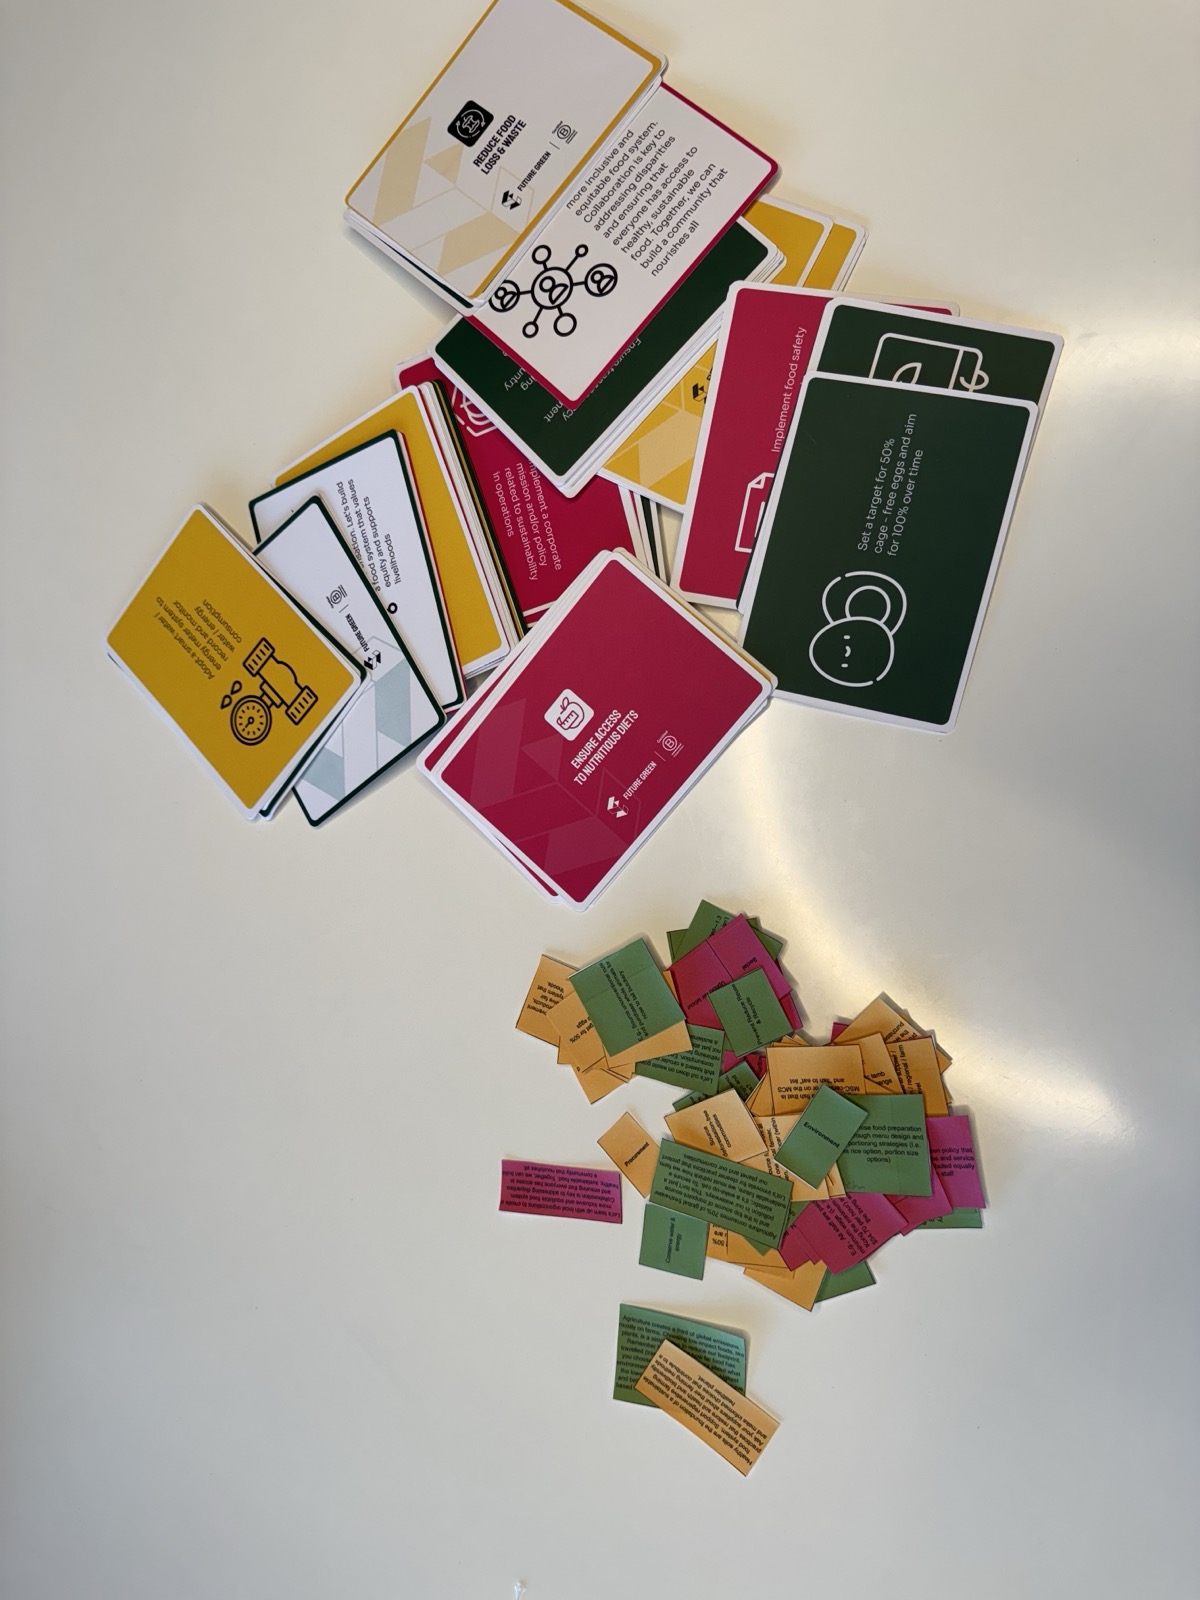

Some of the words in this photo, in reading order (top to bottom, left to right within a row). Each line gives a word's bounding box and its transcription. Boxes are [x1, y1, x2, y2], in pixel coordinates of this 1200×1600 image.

[472, 134, 501, 167] REDUCE
[495, 114, 516, 137] FOOD
[480, 152, 500, 175] LOSS
[496, 146, 506, 155] &
[501, 119, 527, 147] WASTE
[517, 168, 537, 192] FUTURE
[533, 150, 551, 171] GREEN
[566, 185, 588, 209] more
[584, 147, 619, 186] inclusive
[617, 129, 634, 149] and
[575, 175, 611, 216] equitable
[608, 152, 630, 176] food
[628, 122, 658, 154] system.
[583, 164, 636, 223] Collaboration
[632, 155, 643, 165] is
[639, 139, 657, 156] key
[653, 129, 665, 140] to
[593, 182, 637, 231] addressing
[634, 135, 676, 183] disparities
[612, 205, 649, 246] everyone
[645, 188, 662, 206] has
[660, 157, 689, 189] access
[685, 146, 698, 157] to
[602, 219, 619, 239] and
[618, 182, 653, 221] ensuring
[649, 162, 669, 182] that
[620, 220, 653, 253] healthy,
[650, 169, 695, 220] sustainable
[630, 237, 654, 261] food.
[650, 195, 690, 236] Together,
[686, 181, 701, 195] we
[699, 163, 716, 181] can
[639, 243, 663, 269] build
[661, 238, 669, 246] a
[666, 187, 712, 239] community
[708, 168, 728, 188] that
[651, 232, 690, 277] nourishes
[688, 220, 699, 233] all
[770, 392, 792, 452] Implement
[783, 363, 798, 389] food
[791, 326, 807, 361] safety
[904, 413, 917, 435] aim
[879, 438, 895, 464] 50%
[898, 436, 911, 459] and
[874, 465, 887, 482] for
[890, 460, 905, 490] eggs
[908, 449, 923, 476] time
[492, 471, 500, 482] in
[504, 467, 520, 502] related
[516, 462, 531, 501] mission
[336, 481, 348, 506] build
[347, 478, 359, 508] values
[865, 484, 883, 520] target
[882, 491, 897, 515] free
[902, 478, 915, 504] over
[343, 505, 354, 528] Let's
[354, 508, 365, 529] that
[363, 496, 379, 538] supports
[495, 482, 514, 537] operations
[513, 502, 522, 515] to
[525, 502, 540, 534] and/or
[891, 506, 909, 536] 100%
[360, 528, 374, 562] system
[373, 539, 384, 557] and
[516, 515, 538, 580] sustainability
[532, 535, 547, 566] policy
[543, 520, 562, 570] corporate
[857, 530, 871, 551] Set
[874, 524, 888, 554] cage
[886, 539, 899, 556] for
[384, 533, 401, 585] livelihoods
[367, 562, 379, 586] food
[379, 558, 391, 588] equity
[155, 596, 164, 607] to
[372, 585, 381, 593] a
[157, 615, 175, 635] water
[162, 603, 184, 629] system
[172, 600, 198, 627] monitor
[194, 606, 216, 630] energy
[202, 599, 242, 643] consumption
[345, 613, 358, 632] GREEN
[173, 632, 192, 654] smart
[182, 627, 202, 648] meter
[194, 624, 209, 640] and
[216, 633, 235, 653] water
[354, 630, 370, 652] FUTURE
[199, 645, 221, 671] energy
[206, 637, 229, 662] record
[194, 656, 215, 680] Adopt
[570, 736, 599, 769] ENSURE
[594, 709, 621, 741] ACCESS
[573, 772, 587, 785] TO
[582, 731, 621, 776] NUTRITIOUS
[616, 709, 638, 735] DIETS
[622, 777, 643, 800] FUTURE
[639, 760, 657, 780] GREEN
[741, 957, 757, 971] Social
[731, 983, 742, 1002] Reuse
[740, 1001, 753, 1023] Reduce
[745, 996, 759, 1019] Recycle
[749, 1022, 763, 1045] Prevent
[703, 1109, 728, 1157] deforestation-free
[703, 1125, 715, 1146] Source
[712, 1113, 732, 1148] commodities
[803, 1121, 840, 1148] Environment
[847, 1139, 878, 1148] portioning
[890, 1133, 911, 1141] design
[624, 1141, 650, 1167] Procurement
[866, 1156, 891, 1164] options)
[695, 1374, 715, 1389] planet.
[713, 1388, 736, 1406] healthier
